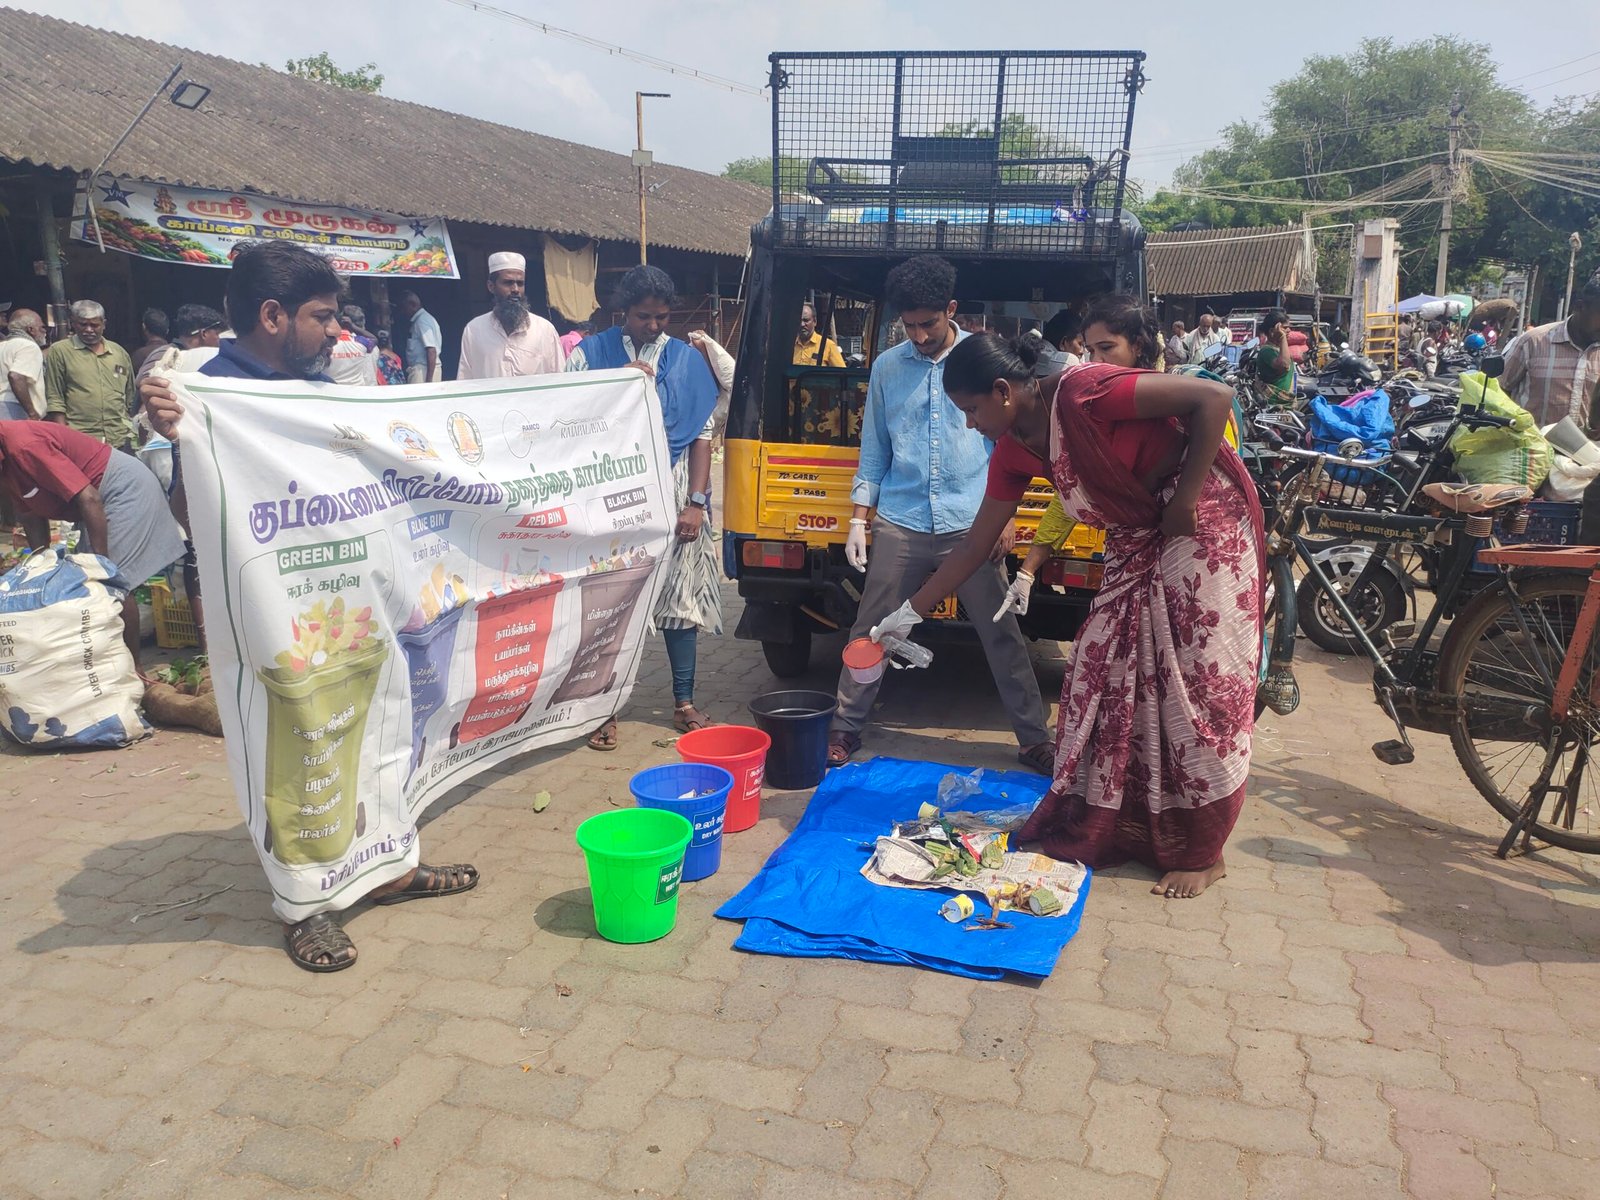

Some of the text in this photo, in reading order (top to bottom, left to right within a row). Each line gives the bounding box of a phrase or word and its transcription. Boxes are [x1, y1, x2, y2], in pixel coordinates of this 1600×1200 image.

[263, 208, 398, 235] முருகன்
[166, 218, 256, 238] காய்கனி
[336, 235, 408, 251] வியாபாரம்
[792, 473, 820, 481] CARRY
[249, 480, 387, 544] குப்பையை
[382, 468, 504, 507] பிரிப்போம்
[572, 442, 647, 490] காப்போம்
[606, 489, 646, 509] BLACK BIN
[411, 512, 446, 535] BLUE BIN
[526, 510, 563, 526] RED BIN
[798, 513, 838, 529] STOP
[1329, 520, 1414, 540] வாழ்க வளமுடன்
[280, 540, 365, 569] GREEN BIN
[286, 573, 360, 599] ஈரக் கழிவு
[83, 645, 94, 671] CHICK
[87, 671, 103, 698] LAYER
[300, 816, 341, 839] மலர்கள்
[695, 816, 715, 830] உலர்
[320, 834, 397, 891] பிரிப்போம்
